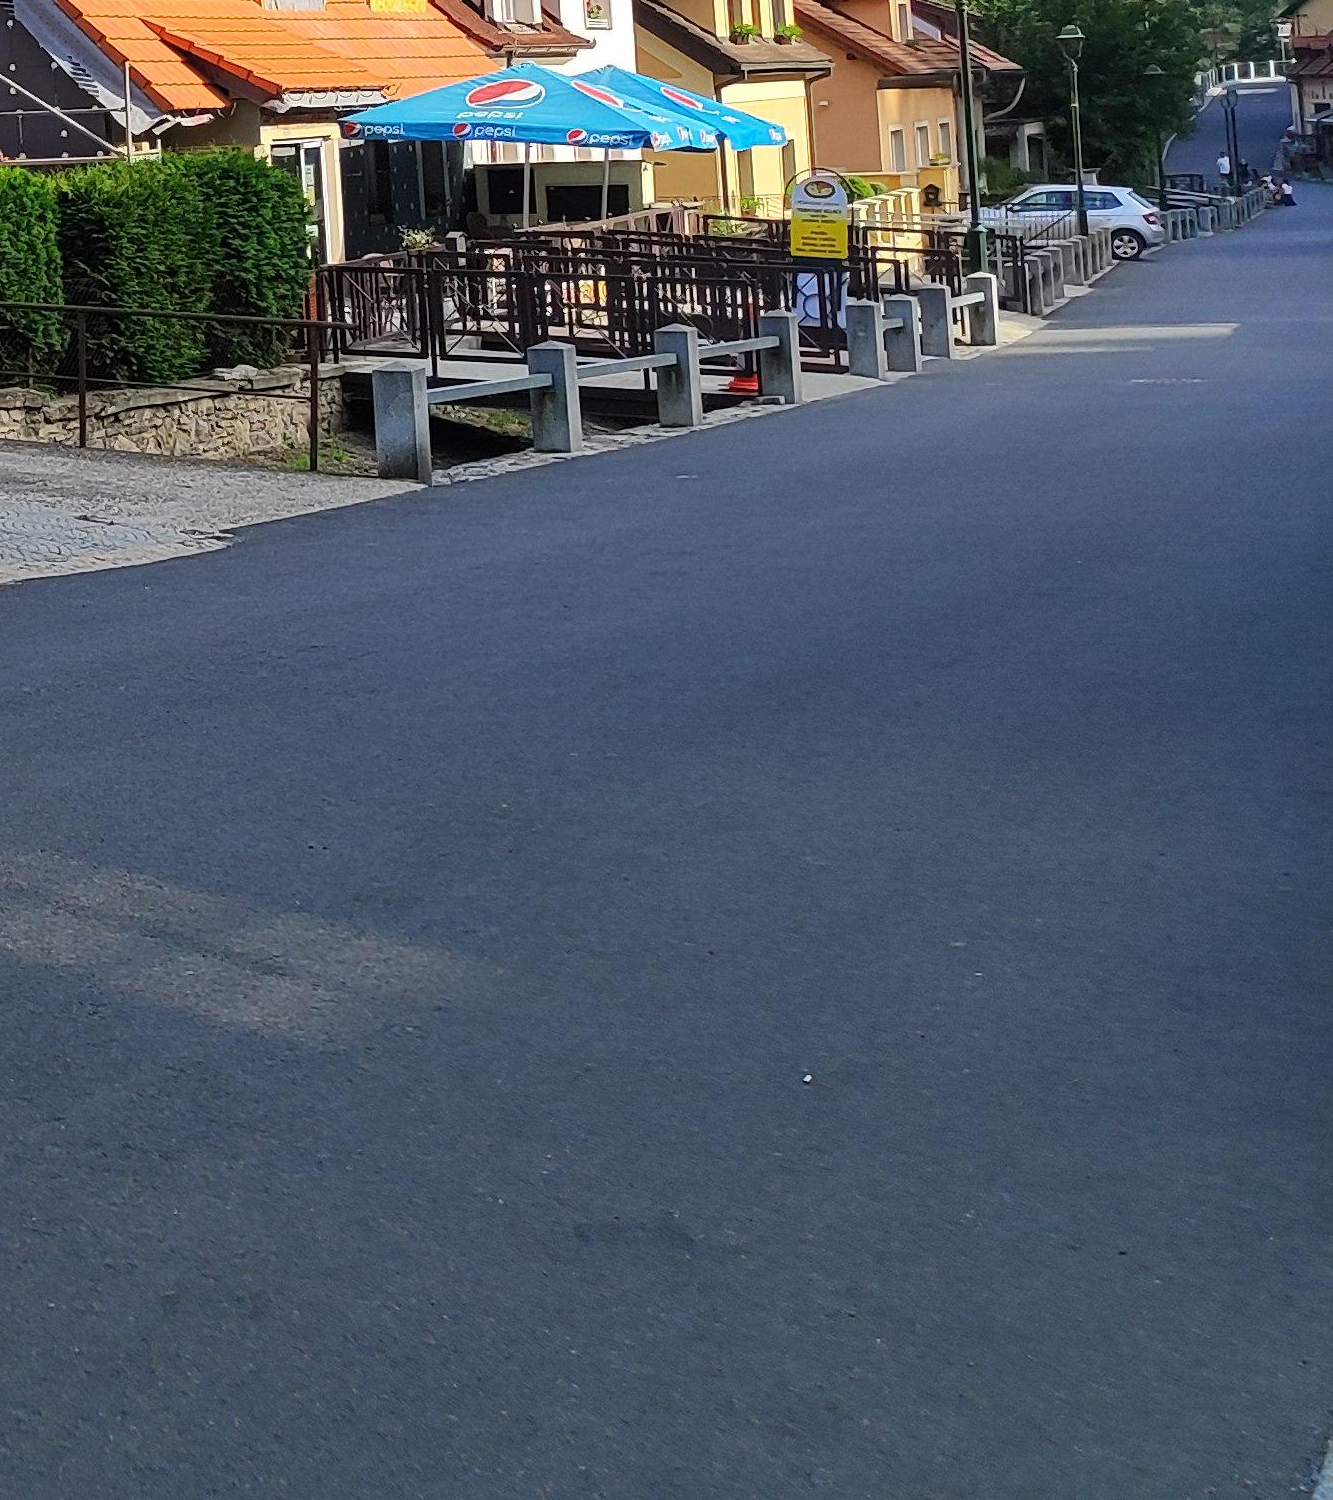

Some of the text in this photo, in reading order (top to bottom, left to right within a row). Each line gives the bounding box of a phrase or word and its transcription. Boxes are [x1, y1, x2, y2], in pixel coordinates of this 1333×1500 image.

[456, 110, 525, 120] pepsi
[363, 123, 405, 138] pepsi
[474, 125, 518, 139] pepsi
